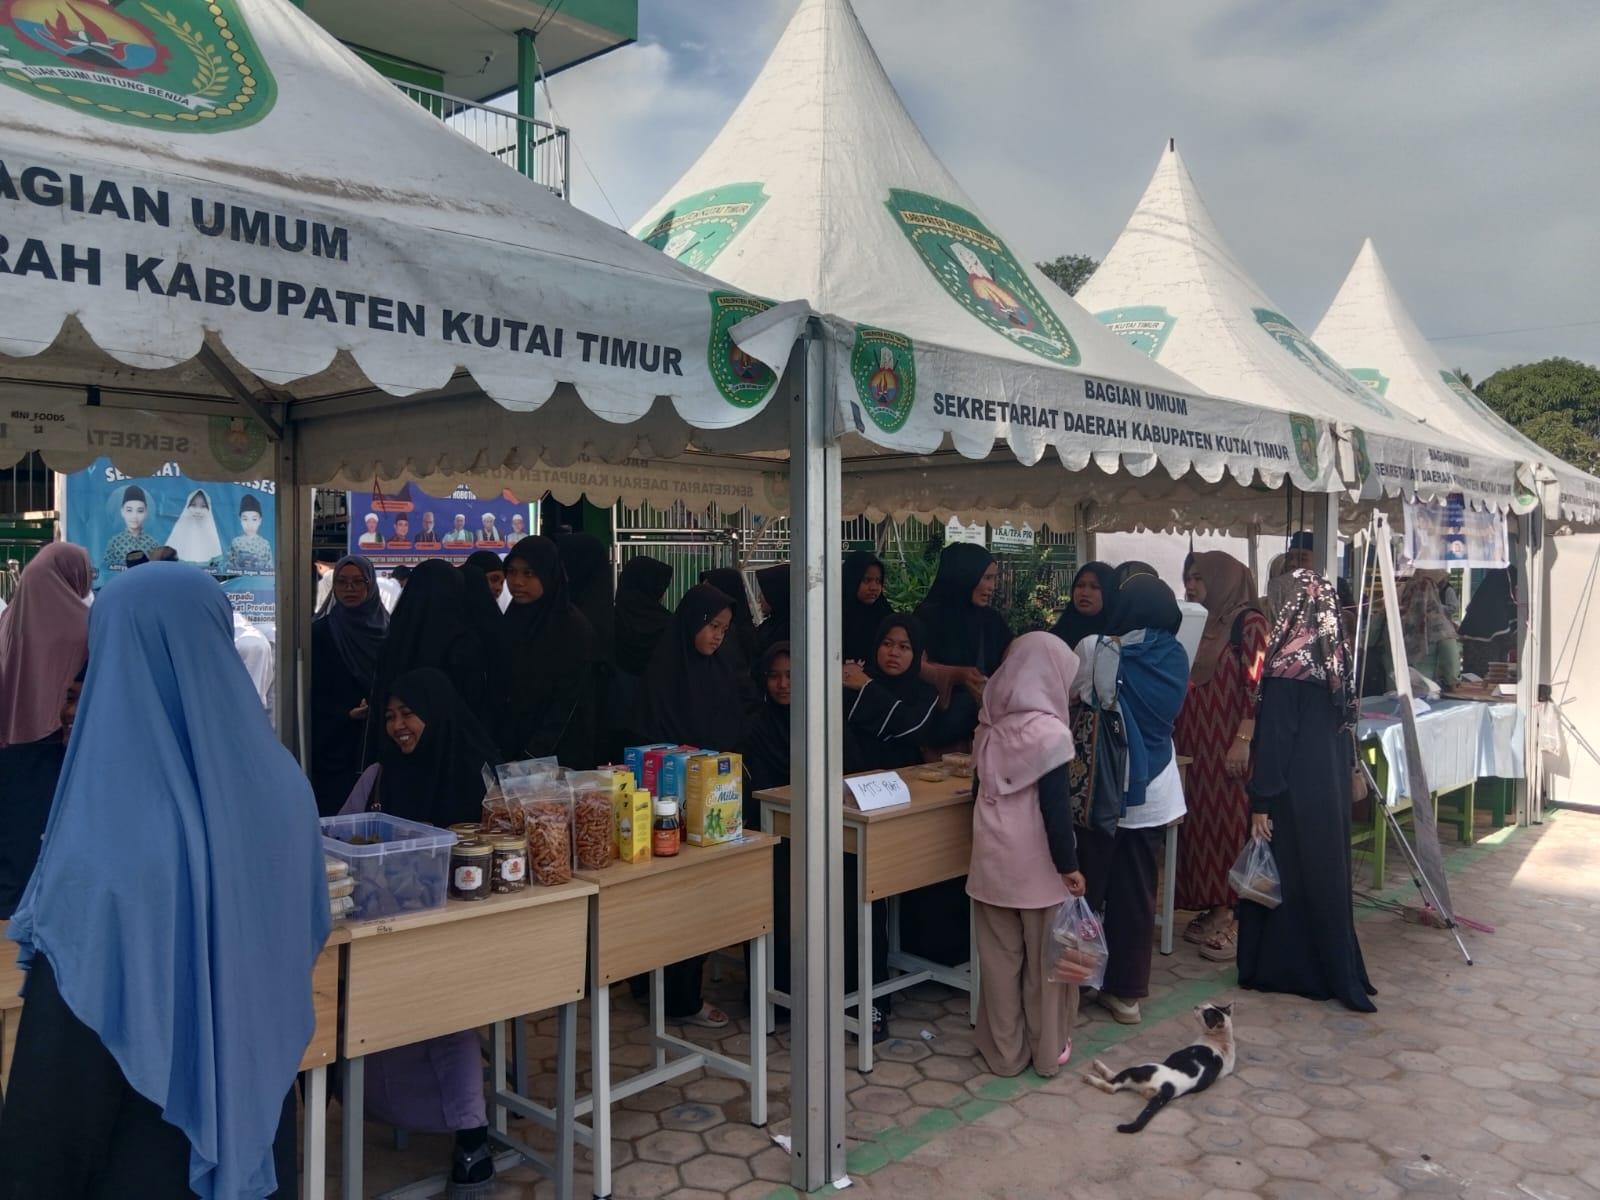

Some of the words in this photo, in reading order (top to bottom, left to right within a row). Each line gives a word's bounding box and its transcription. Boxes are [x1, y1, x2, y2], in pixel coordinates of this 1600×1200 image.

[22, 66, 57, 77] TUAH
[60, 69, 91, 80] BUMI
[95, 75, 145, 92] UNTUNG
[148, 87, 190, 106] BENUA
[191, 197, 348, 262] UMUM
[125, 253, 425, 337] KABUPATEN
[442, 309, 563, 358] KUTAI
[577, 331, 684, 376] TIMUR
[933, 392, 1059, 429] SEKRETARIAT
[1064, 411, 1127, 439] DAERAH
[1132, 421, 1213, 450] KABUPATEN
[1216, 435, 1252, 455] KUTAI
[1254, 441, 1290, 461] TIMUR
[1084, 380, 1141, 408] BAGIAN
[1146, 393, 1188, 416] UMUM
